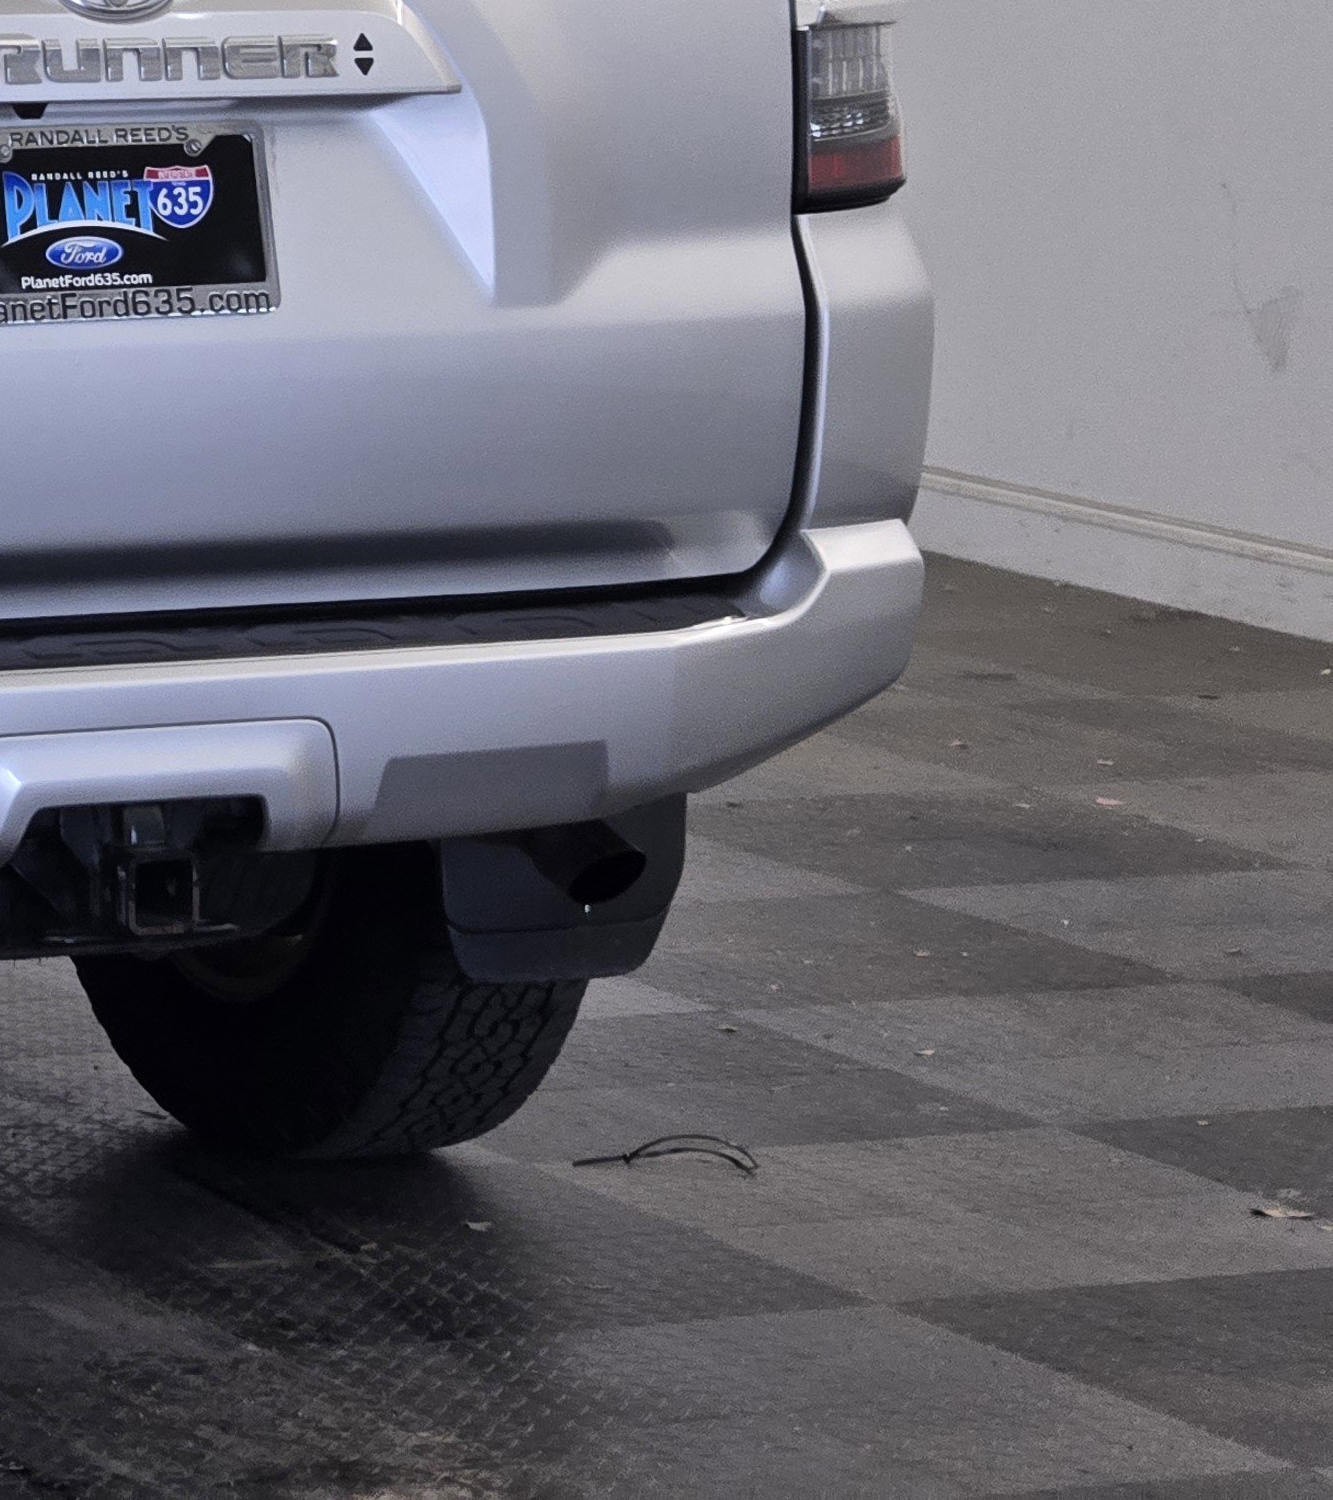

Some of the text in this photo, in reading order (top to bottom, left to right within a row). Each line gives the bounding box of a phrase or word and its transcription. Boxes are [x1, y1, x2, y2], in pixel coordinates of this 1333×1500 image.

[9, 125, 190, 148] RANDALL REED'S
[31, 172, 82, 181] RANDALL
[2, 171, 154, 242] PLANET
[156, 186, 204, 217] 635
[60, 242, 107, 265] Ford
[21, 273, 153, 290] PlanetFord635.com
